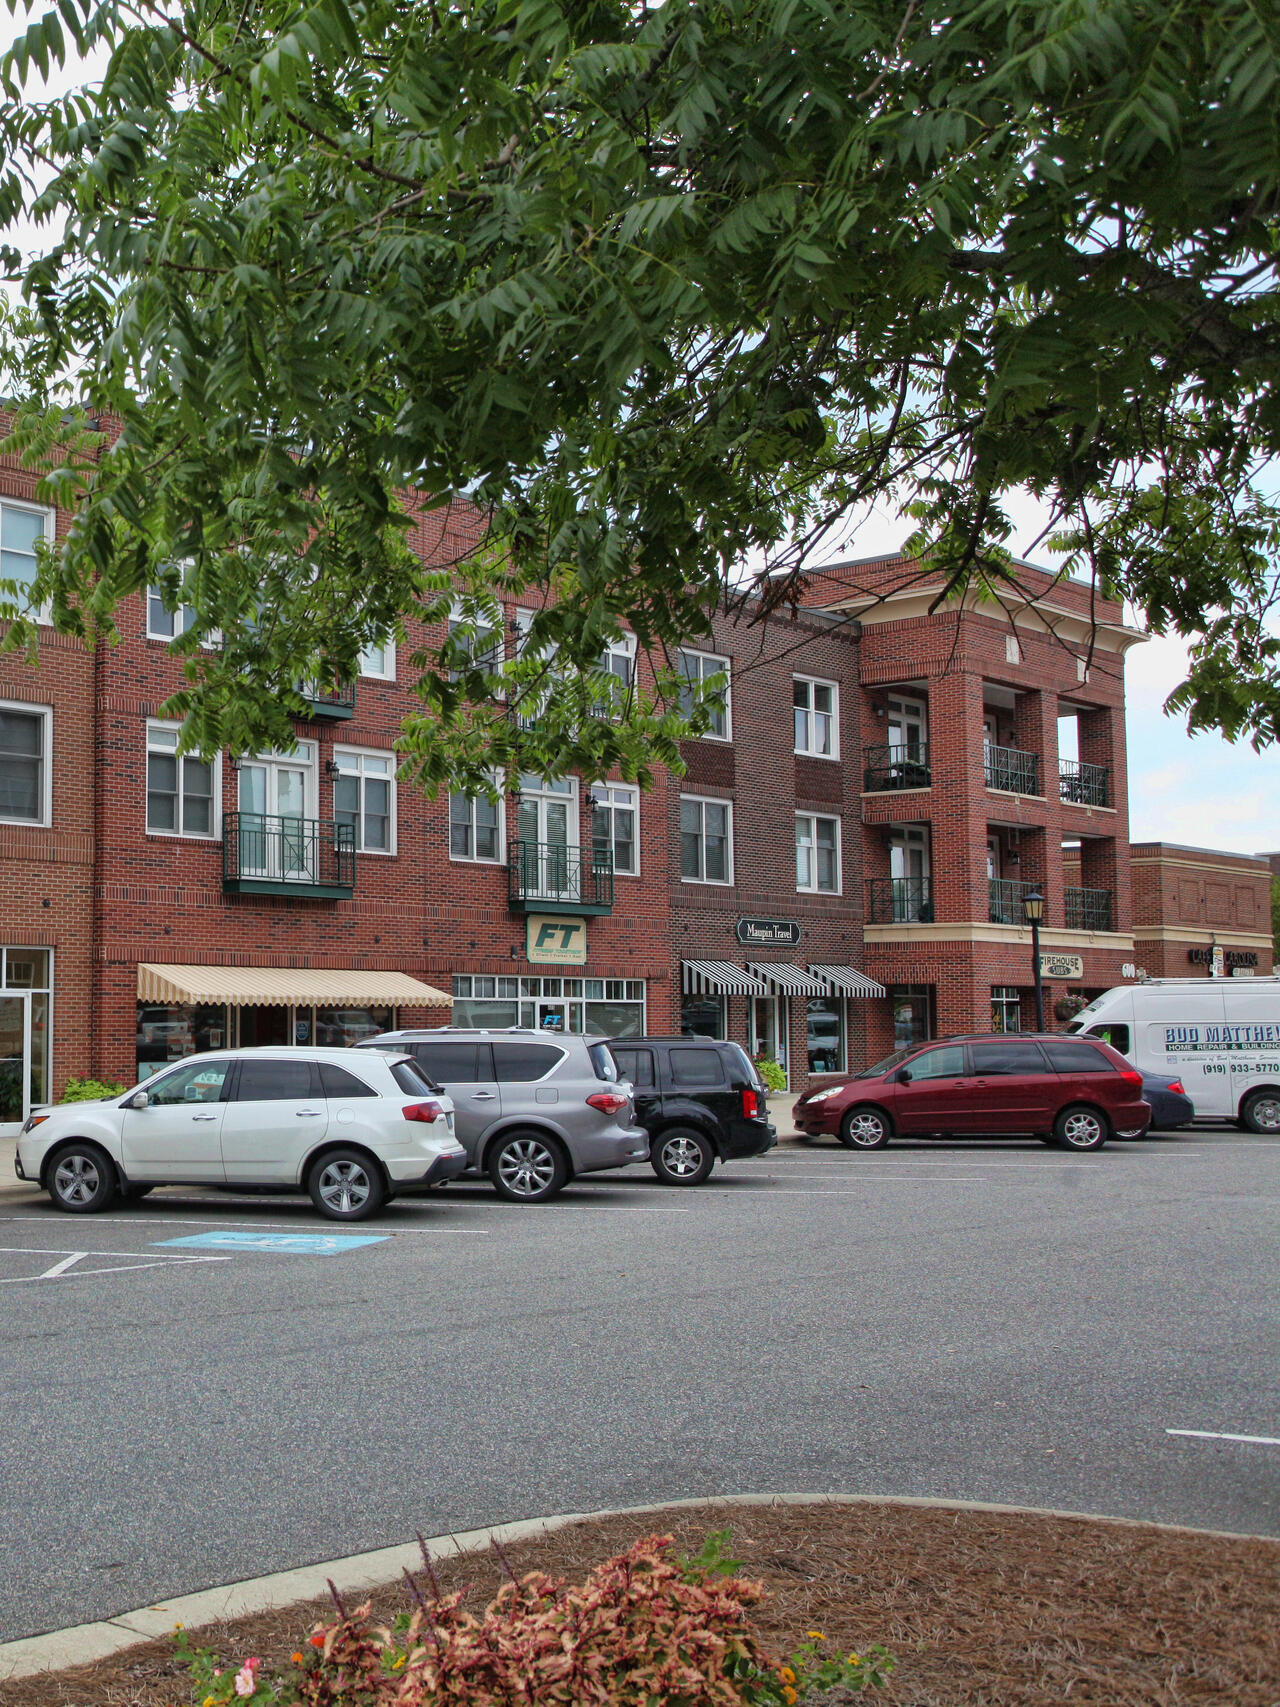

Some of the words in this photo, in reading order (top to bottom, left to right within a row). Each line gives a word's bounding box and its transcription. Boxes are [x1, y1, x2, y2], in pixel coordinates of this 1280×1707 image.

[535, 923, 581, 949] FT
[747, 923, 772, 941] Maupin
[773, 924, 792, 939] Travel
[1122, 963, 1135, 978] 600
[543, 1015, 562, 1025] FT
[1164, 1027, 1199, 1043] BUD
[1204, 1025, 1280, 1043] MATTHE
[1197, 1043, 1228, 1051] REPAIR
[1203, 1064, 1226, 1075] (919)
[1231, 1063, 1280, 1073] 933-5770
